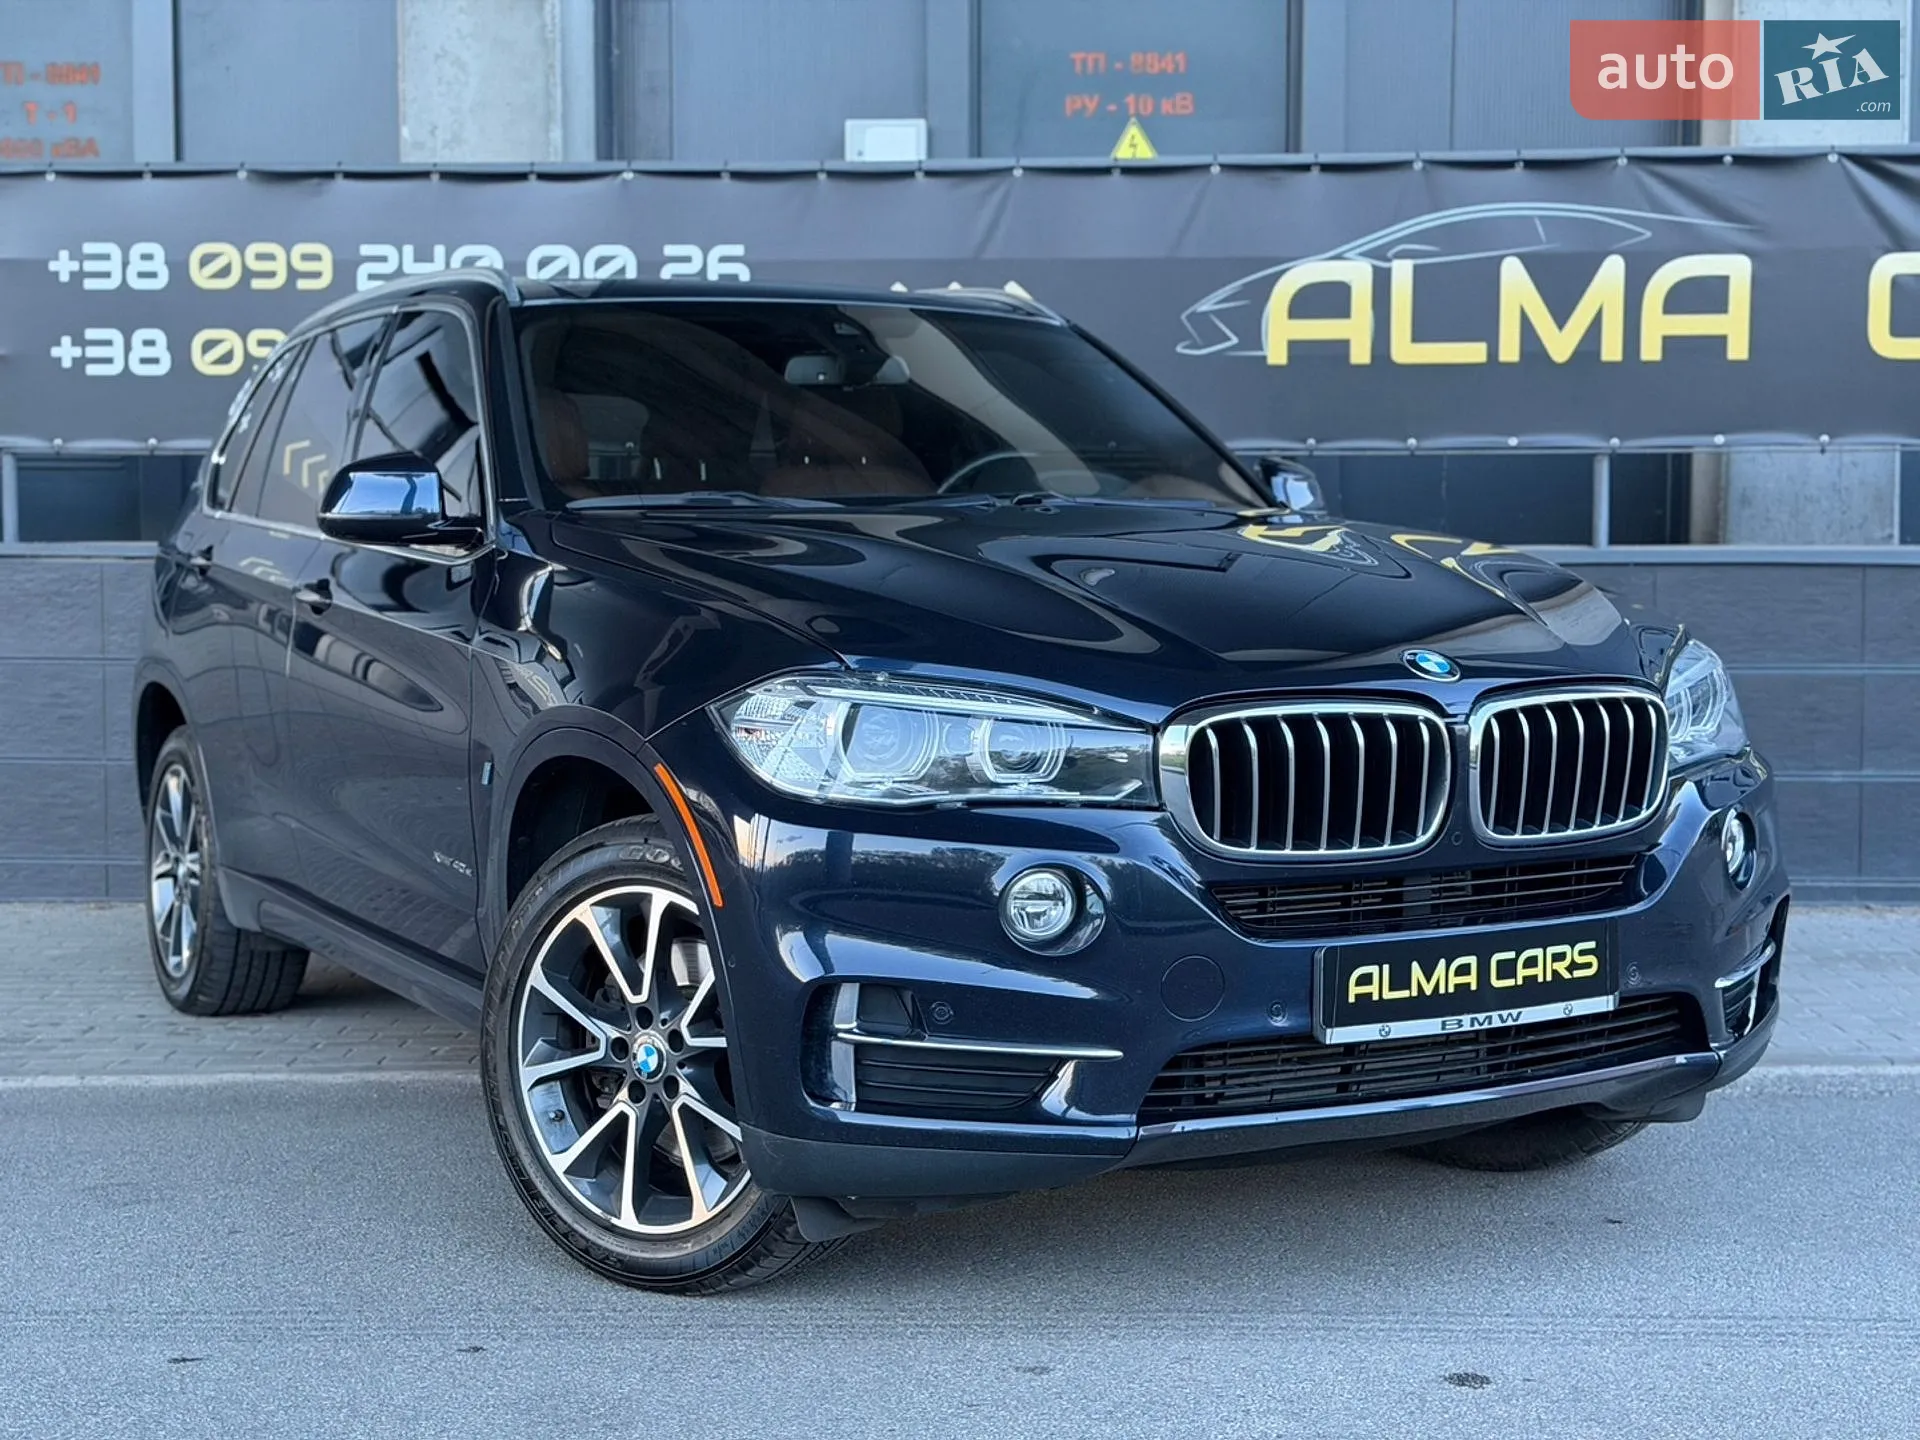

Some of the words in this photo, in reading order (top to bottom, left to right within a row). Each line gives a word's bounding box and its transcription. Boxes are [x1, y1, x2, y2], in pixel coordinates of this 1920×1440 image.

[1070, 52, 1106, 74] ТП
[1065, 94, 1099, 117] РУ
[1126, 94, 1154, 116] 10
[48, 242, 169, 290] +38
[189, 242, 333, 290] 099
[526, 244, 637, 280] 00
[660, 244, 751, 282] 26
[1266, 253, 1752, 365] ALMA
[50, 328, 171, 376] +38
[1348, 955, 1478, 1004] ALMA
[1490, 940, 1599, 988] CARS
[1441, 1011, 1523, 1032] BMW
